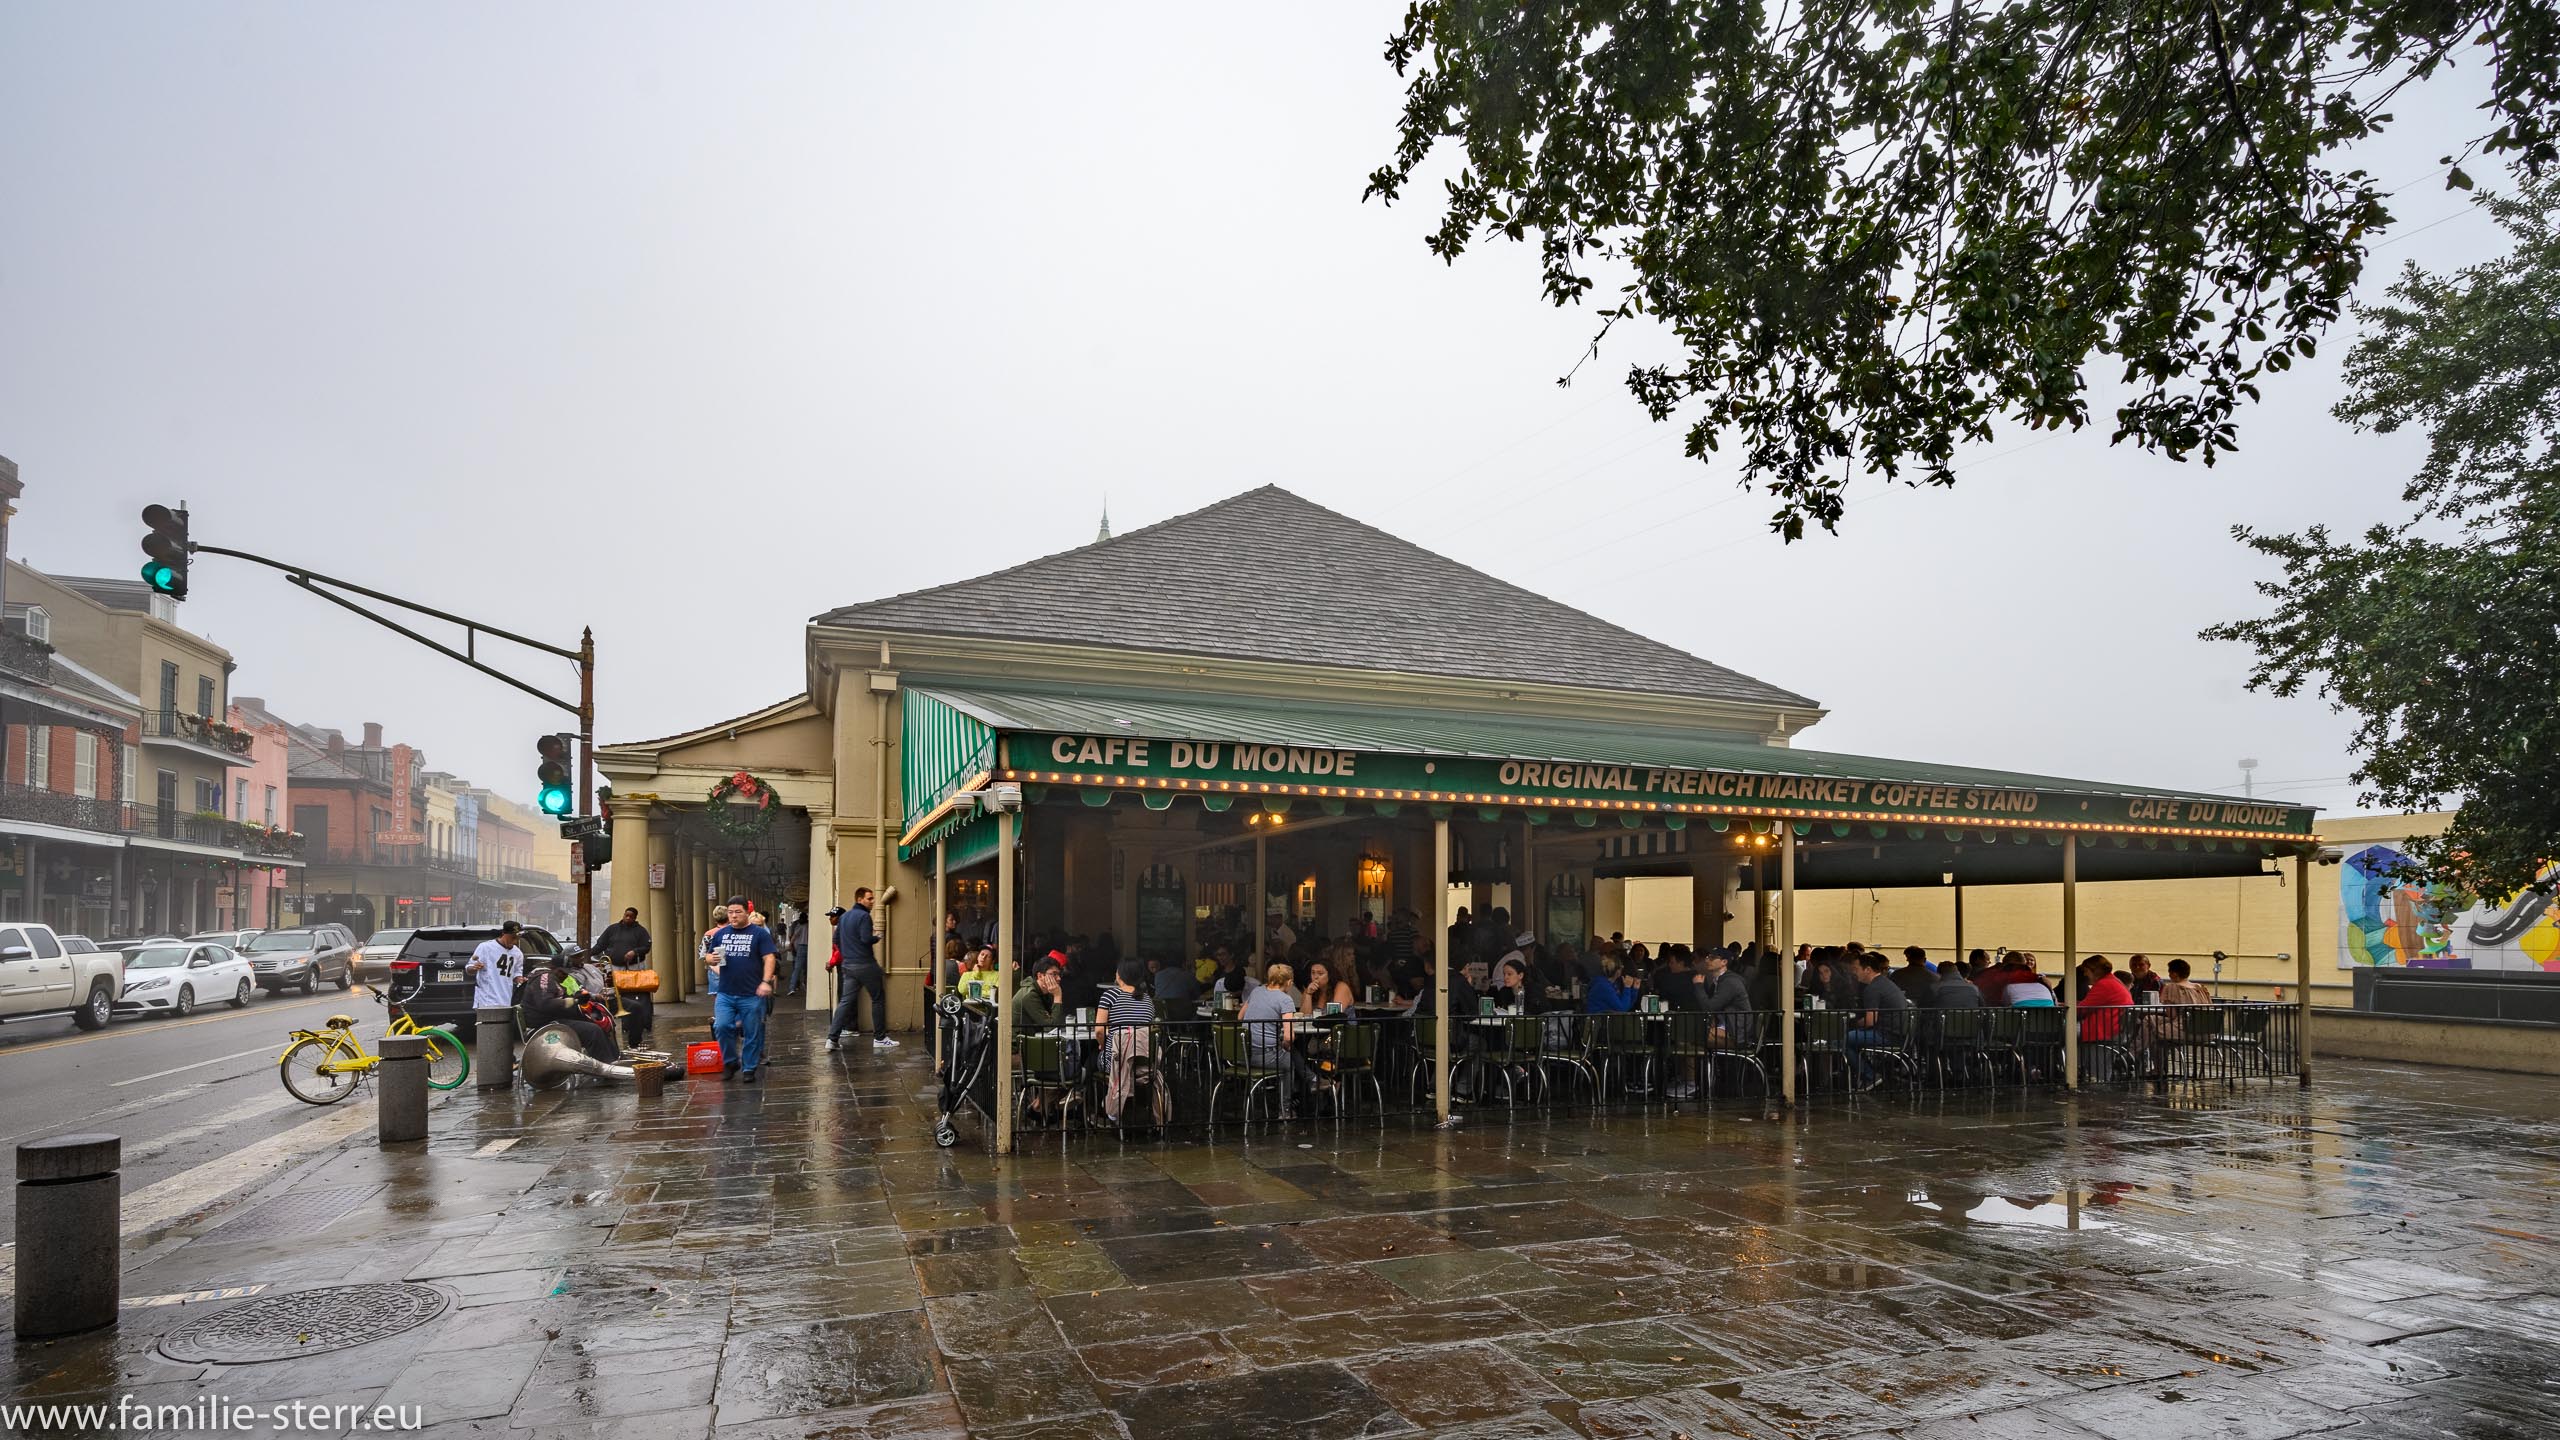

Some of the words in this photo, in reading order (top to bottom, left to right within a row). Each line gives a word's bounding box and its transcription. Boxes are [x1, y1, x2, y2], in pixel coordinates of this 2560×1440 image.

[1051, 736, 1149, 767] CAFE
[1170, 742, 1220, 770] DU
[1232, 744, 1356, 777] MONDE
[1499, 761, 1638, 791] ORIGINAL
[1645, 769, 1756, 797] FRENCH
[1759, 776, 1865, 803] MARKET
[1870, 783, 1961, 809] COFFEE
[1964, 789, 2038, 813] STAND
[2128, 799, 2180, 821] CAFE
[2188, 803, 2218, 822] DU
[2221, 804, 2289, 826] MONDE
[565, 826, 577, 835] St.
[580, 823, 598, 832] Ann
[730, 933, 754, 941] COURSE
